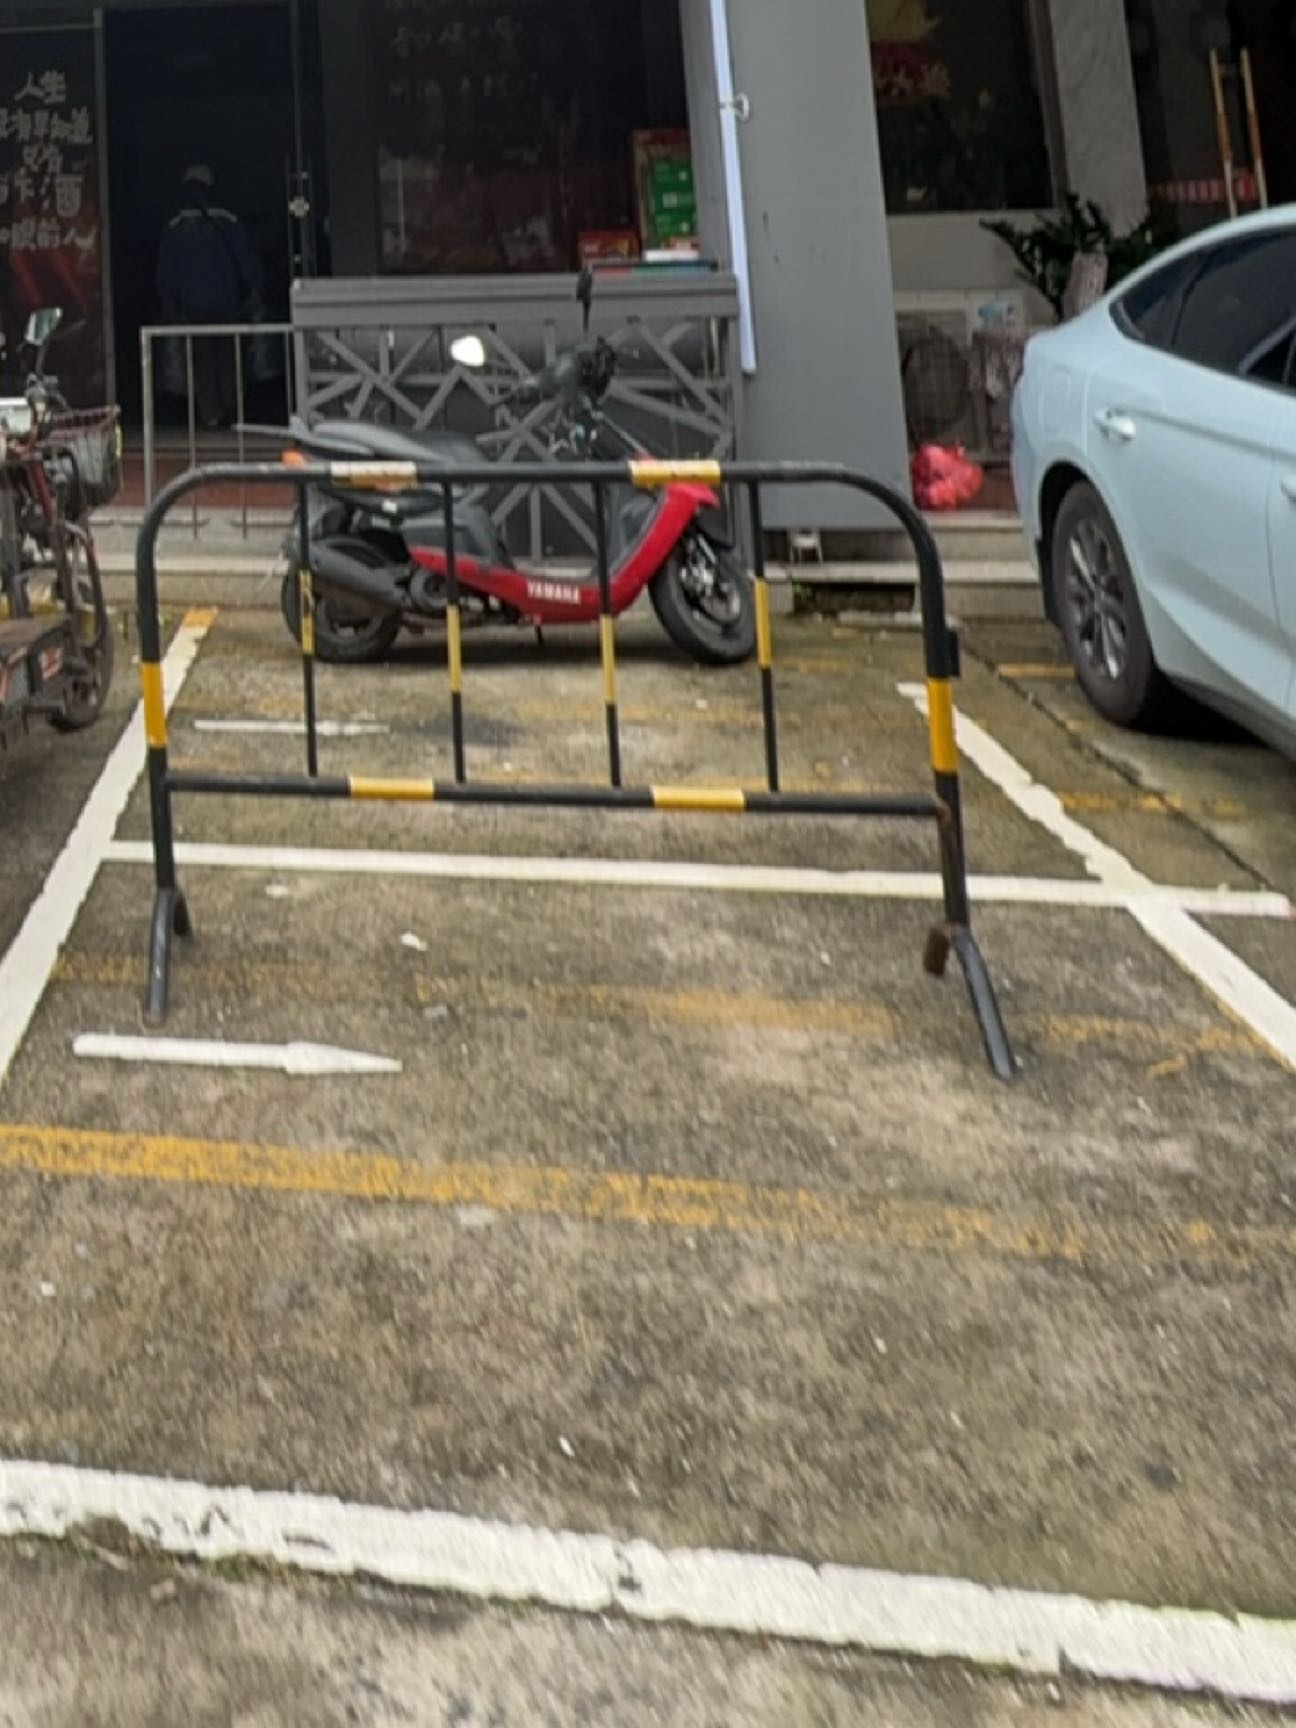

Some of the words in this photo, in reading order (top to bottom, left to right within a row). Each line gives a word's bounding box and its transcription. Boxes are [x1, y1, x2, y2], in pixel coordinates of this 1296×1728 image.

[13, 68, 68, 106] 人生
[21, 142, 65, 174] 只有
[526, 579, 582, 606] YAMAHA
